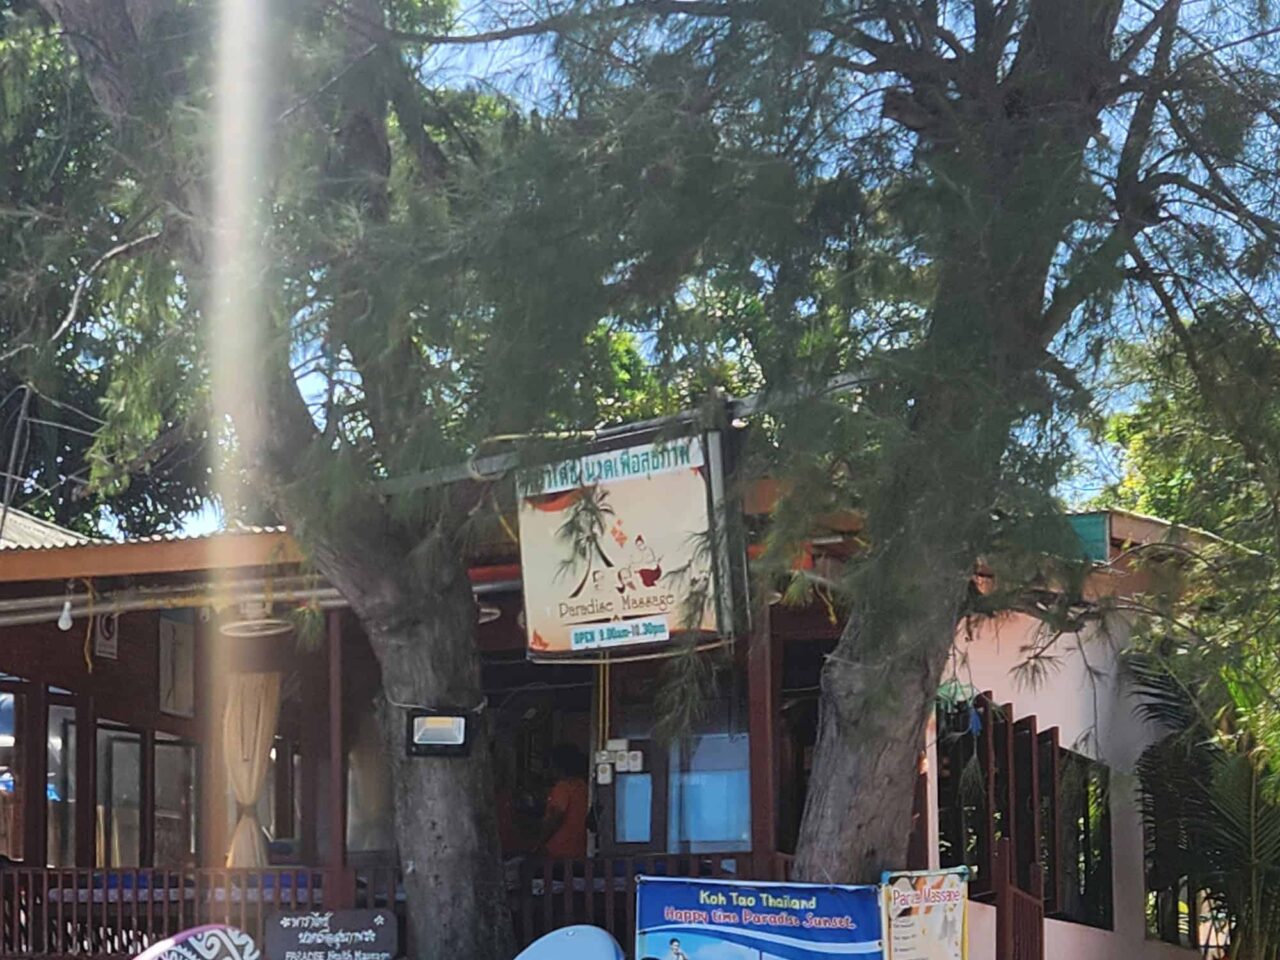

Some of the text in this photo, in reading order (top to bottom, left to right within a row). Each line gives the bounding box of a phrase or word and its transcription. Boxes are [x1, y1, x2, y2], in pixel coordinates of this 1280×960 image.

[559, 594, 674, 618] Paradise Massage
[573, 630, 596, 644] OPEN
[699, 890, 817, 909] Koh Tao Thailand
[664, 906, 708, 925] Happy
[712, 908, 739, 923] time
[743, 909, 800, 926] Paradise
